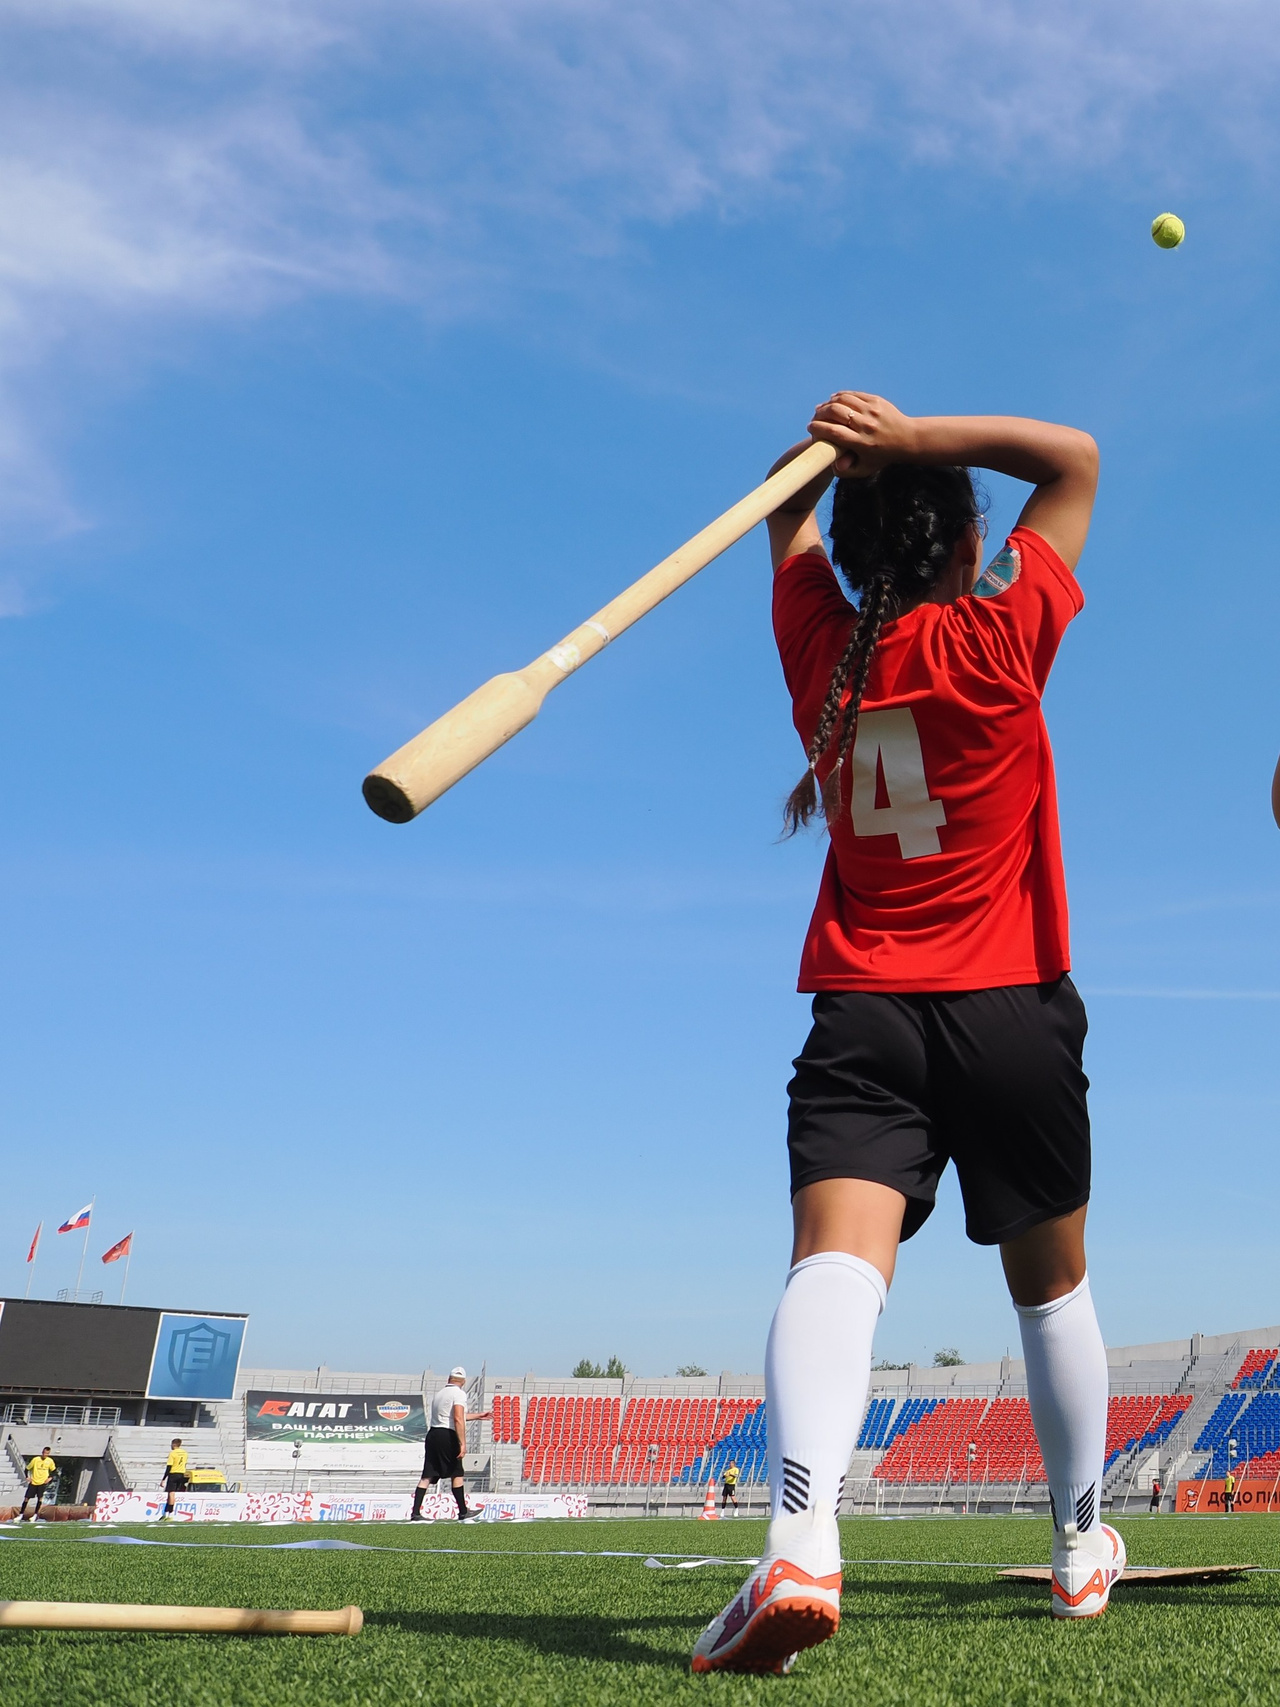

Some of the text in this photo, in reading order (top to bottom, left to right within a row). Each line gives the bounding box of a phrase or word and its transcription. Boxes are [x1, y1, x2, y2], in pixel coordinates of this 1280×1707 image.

[851, 707, 947, 859] 4
[286, 1402, 353, 1418] АГАТ
[271, 1423, 308, 1431] ВАШ
[155, 1503, 197, 1516] ЛПТА
